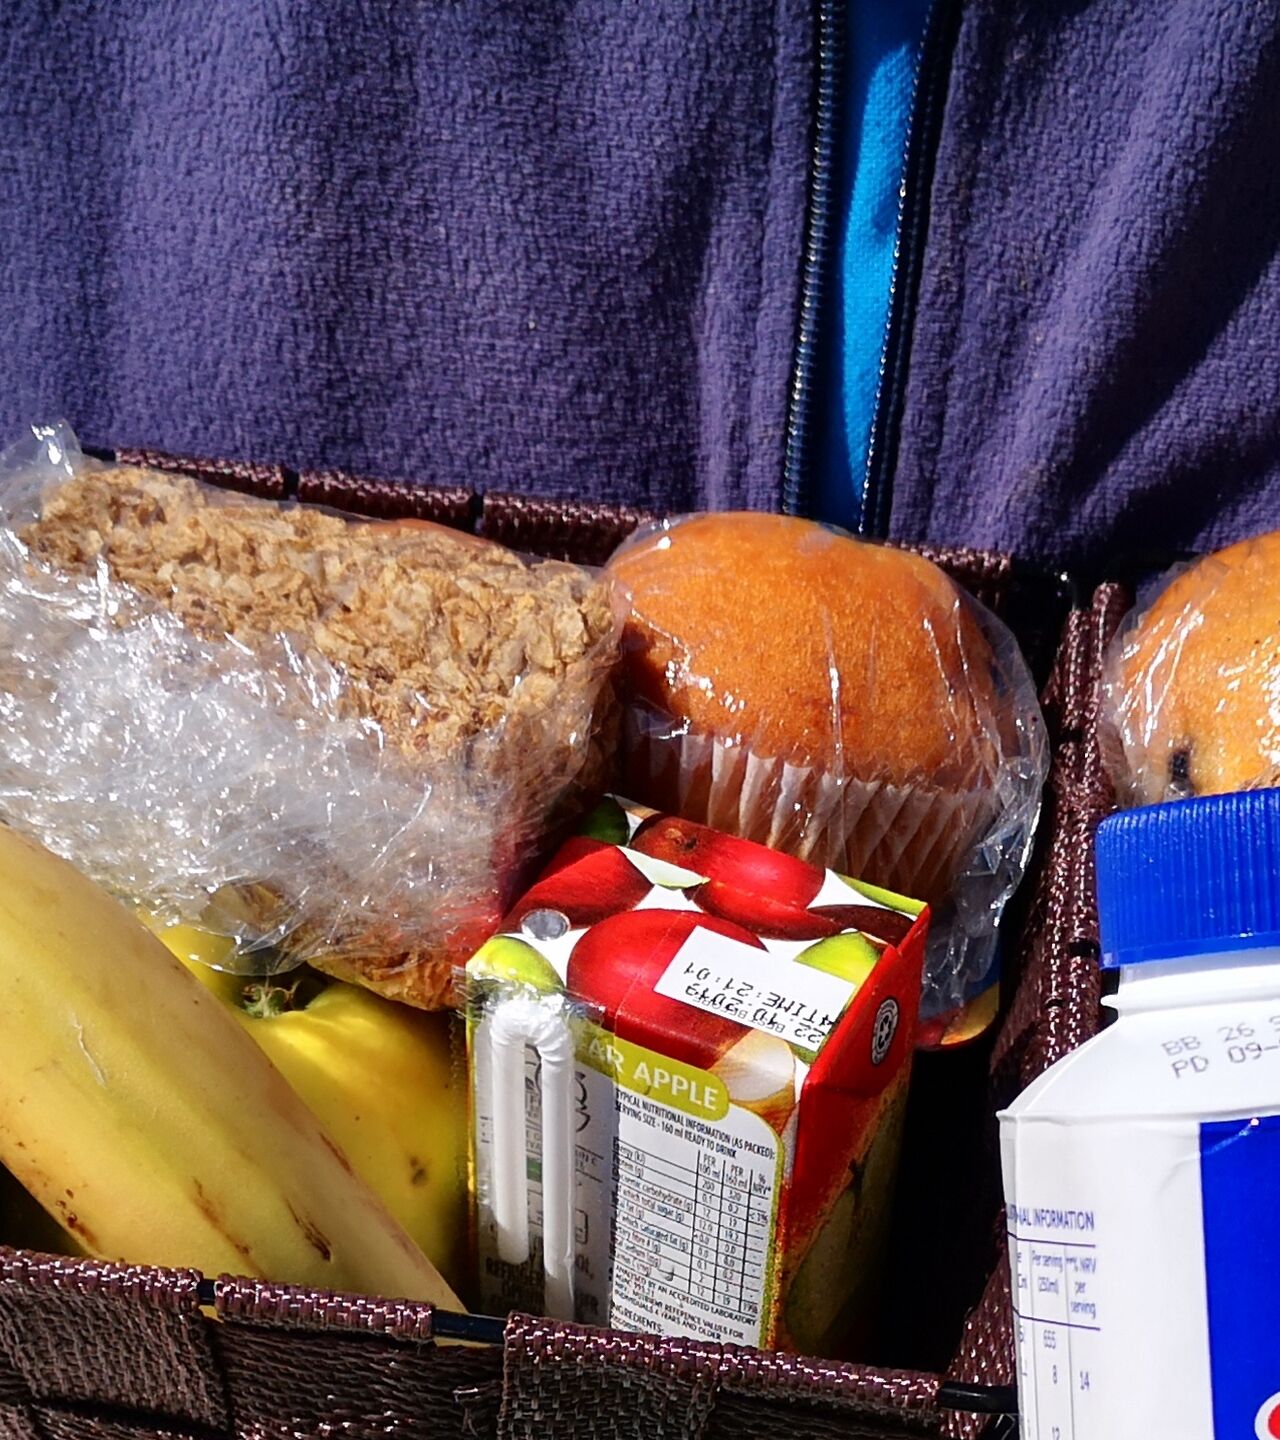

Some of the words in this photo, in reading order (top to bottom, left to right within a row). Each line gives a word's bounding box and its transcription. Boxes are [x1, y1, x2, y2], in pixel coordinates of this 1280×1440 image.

[1162, 1035, 1201, 1057] BB
[1217, 1023, 1256, 1043] 26
[633, 1056, 722, 1111] APPLE
[1171, 1056, 1209, 1079] PD
[642, 1103, 685, 1125] NUTRITIONAL
[685, 1116, 731, 1143] INFORMATION
[642, 1112, 656, 1128] SIZE
[661, 1122, 673, 1134] 160
[684, 1130, 706, 1151] READY
[707, 1140, 715, 1150] TO
[715, 1143, 736, 1159] DRINK
[703, 1153, 716, 1166] PER
[731, 1164, 744, 1177] PER
[1033, 1210, 1095, 1232] INFORMATION
[664, 1302, 702, 1324] REFERENCE
[728, 1328, 744, 1340] FOR
[668, 1286, 710, 1312] ACCREDITED
[711, 1305, 757, 1327] LABORATORY
[682, 1318, 698, 1331] AND
[698, 1326, 721, 1340] OLDER
